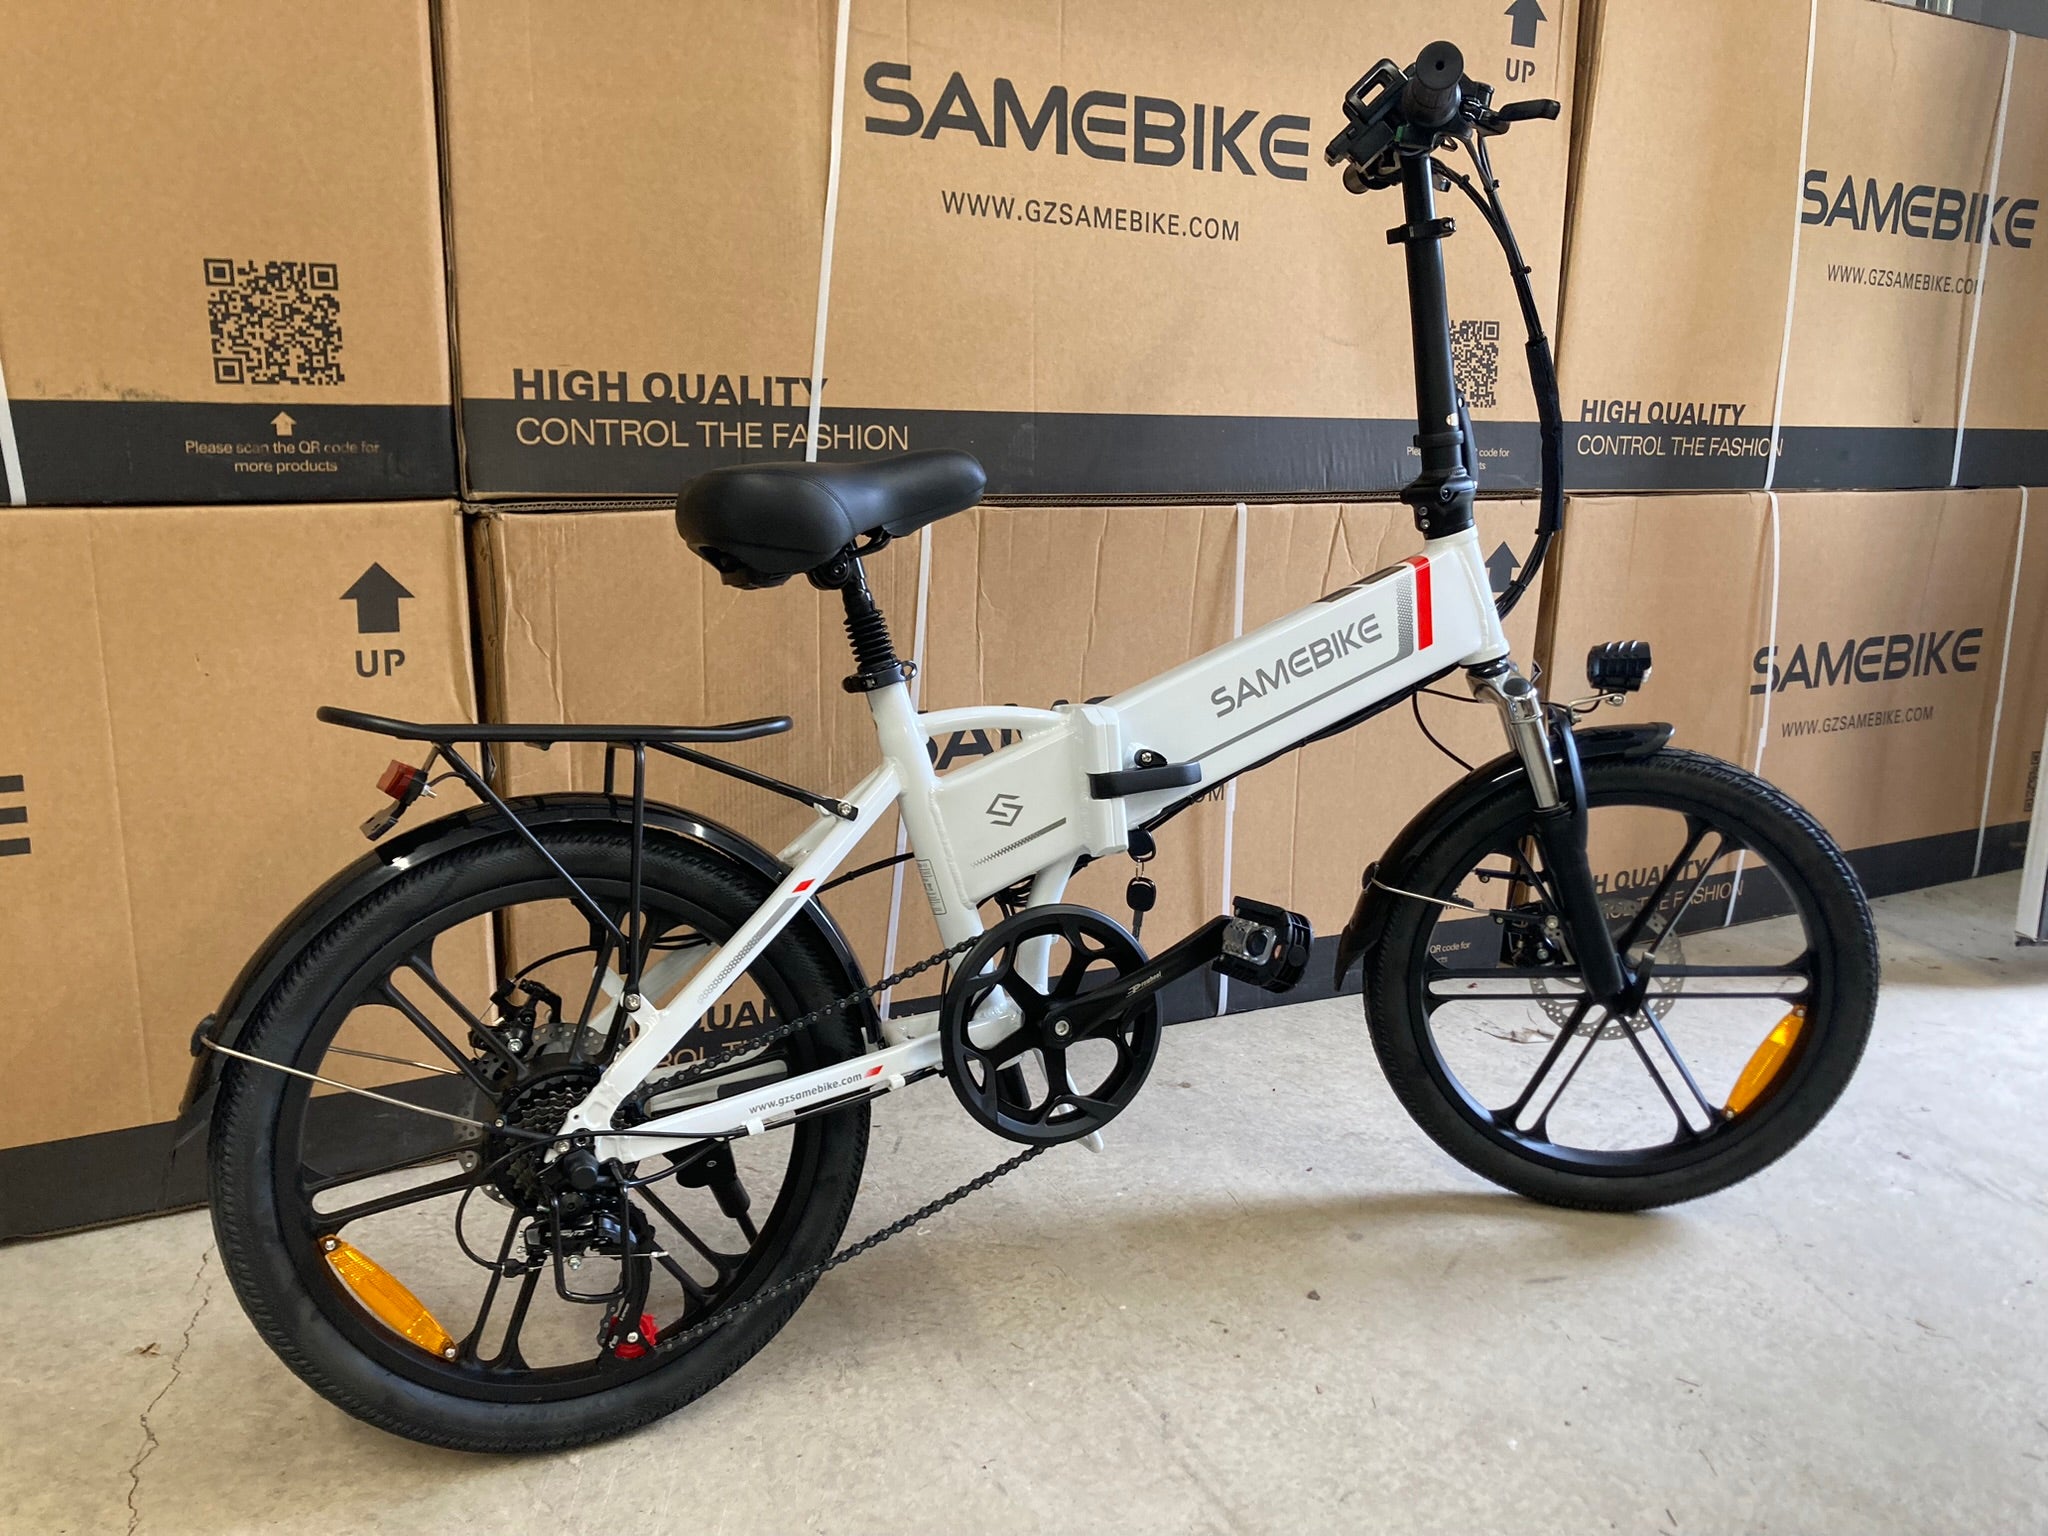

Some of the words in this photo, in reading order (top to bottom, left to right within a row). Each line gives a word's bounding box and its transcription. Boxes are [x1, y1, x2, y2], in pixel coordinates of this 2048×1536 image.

[1505, 57, 1536, 83] UP
[863, 61, 1311, 181] SAMEBIKE
[941, 190, 1240, 242] WWW.GZSAMEBIKE.COM
[1800, 169, 2040, 249] SAMEBIKE
[512, 368, 628, 403] HIGH
[1579, 399, 1642, 424] HIGH
[1647, 401, 1747, 426] QUALITY
[184, 440, 233, 454] Please
[236, 443, 270, 455] scan
[273, 441, 296, 455] the
[298, 440, 320, 455] QR
[323, 441, 358, 455] code
[360, 440, 381, 454] for
[515, 417, 690, 449] CONTROL
[695, 421, 764, 449] THE
[771, 423, 909, 451] FASHION
[1576, 434, 1666, 456] CONTROL
[1671, 436, 1706, 456] THE
[234, 461, 273, 473] more
[276, 459, 338, 475] products
[1478, 447, 1498, 457] code
[1498, 447, 1510, 457] for
[355, 648, 406, 678] UP
[1210, 613, 1383, 719] SAMEBIKE
[1749, 628, 1984, 695] SAMEBIKE
[1780, 705, 1935, 738] WWW.GZSAMEBIKE.COM
[748, 1072, 863, 1115] www.gzsamebike.com
